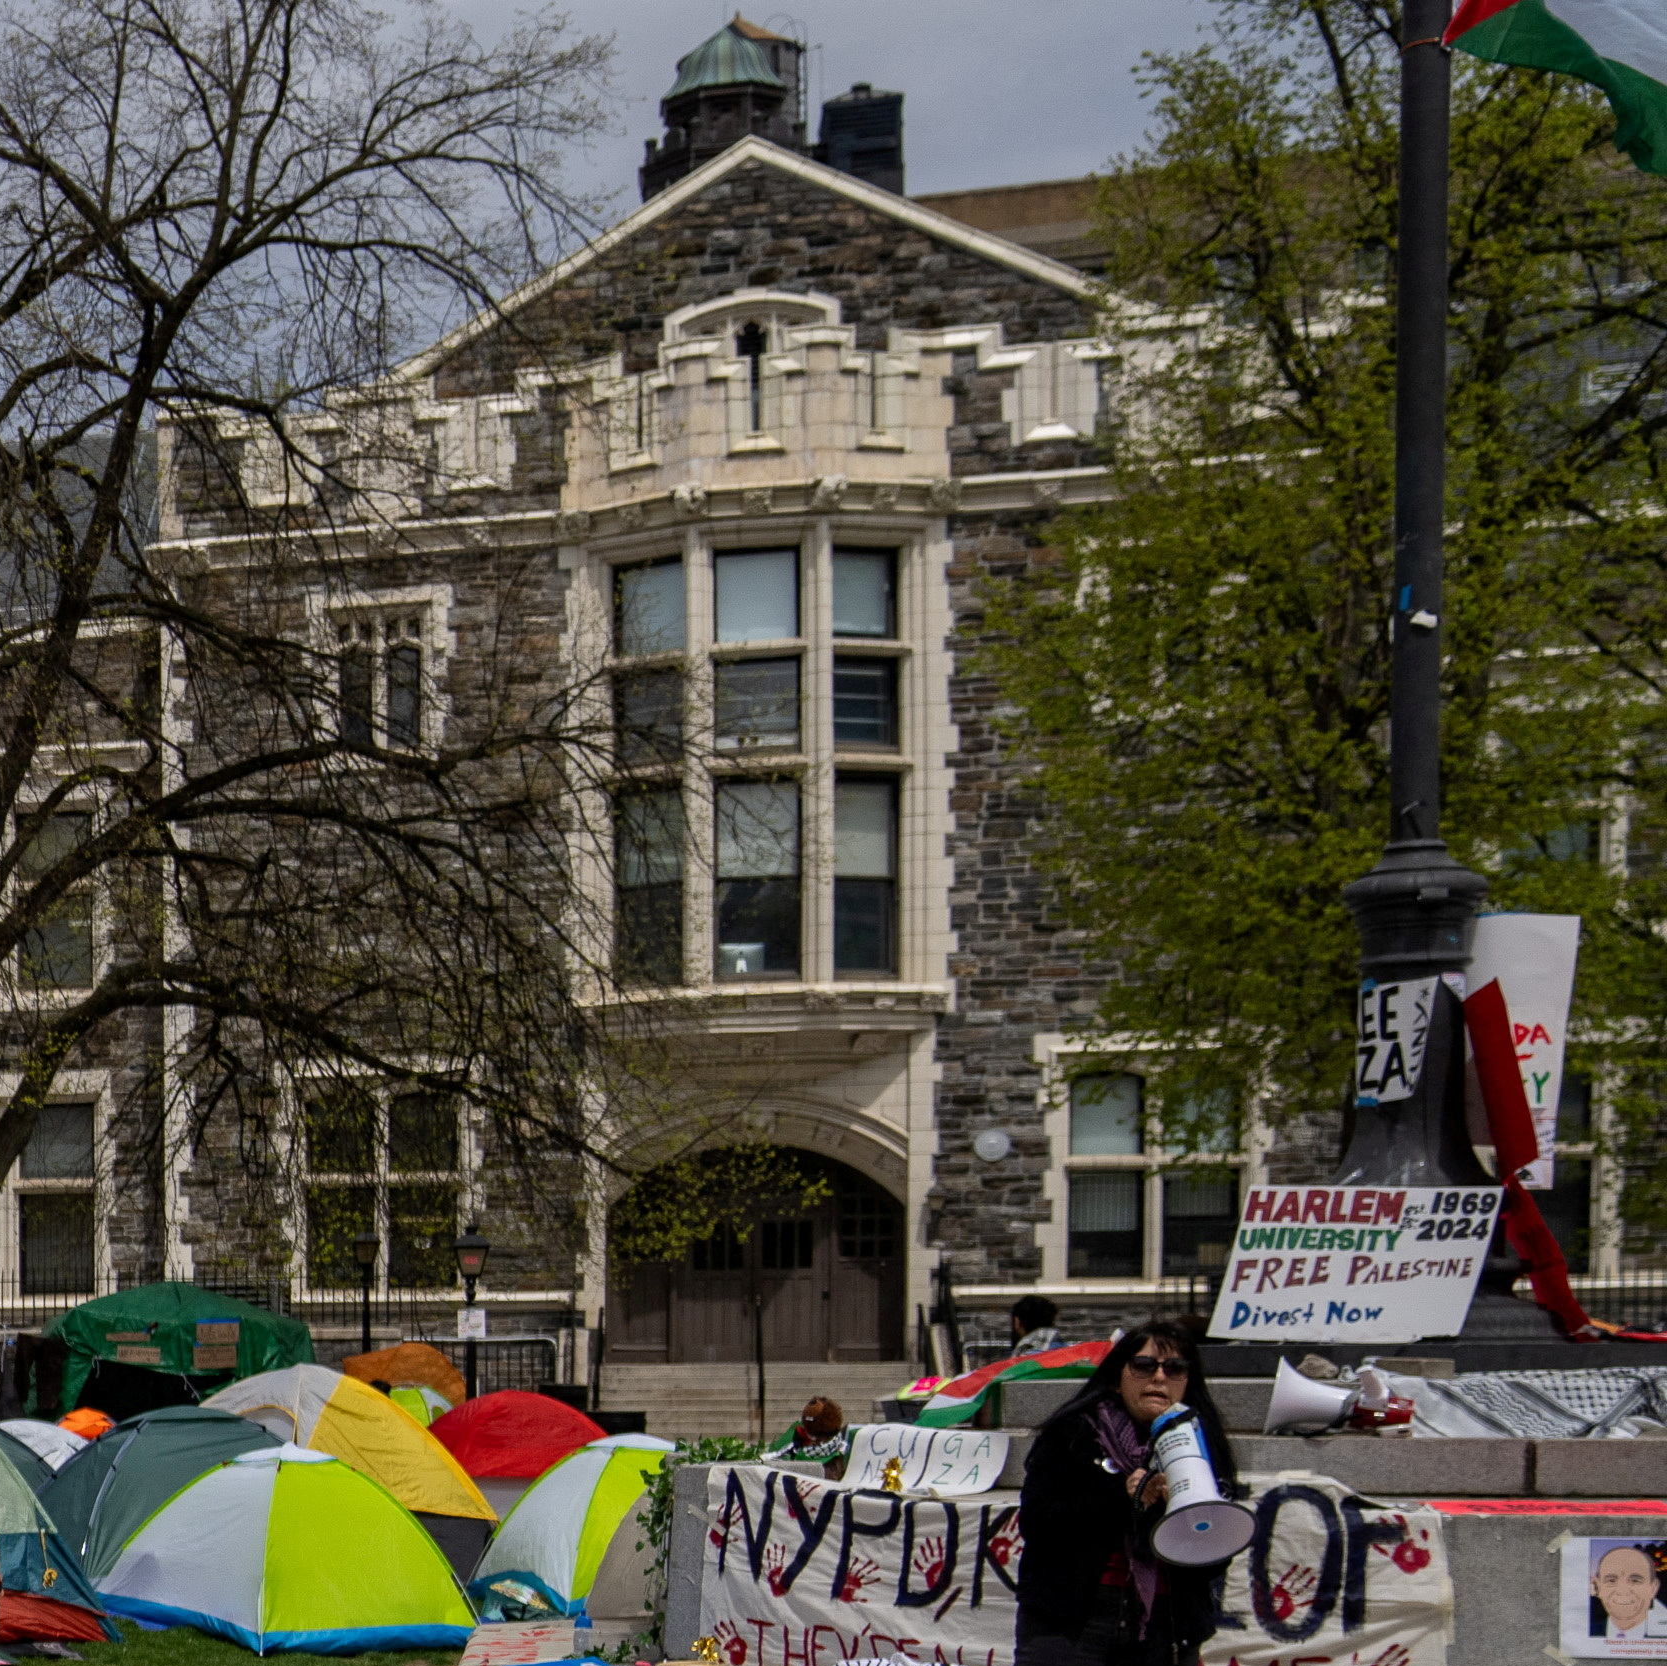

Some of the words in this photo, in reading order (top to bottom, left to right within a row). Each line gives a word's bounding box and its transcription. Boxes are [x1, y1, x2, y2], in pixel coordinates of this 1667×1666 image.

[1244, 1189, 1408, 1225] HARLEM
[1430, 1190, 1499, 1216] 1969
[1238, 1228, 1403, 1253] UNIVERSITY
[1415, 1217, 1491, 1242] 2024
[1230, 1255, 1331, 1294] FREE
[1347, 1254, 1474, 1287] PALESTINE
[1229, 1300, 1315, 1330] Divest
[1325, 1300, 1384, 1325] Now
